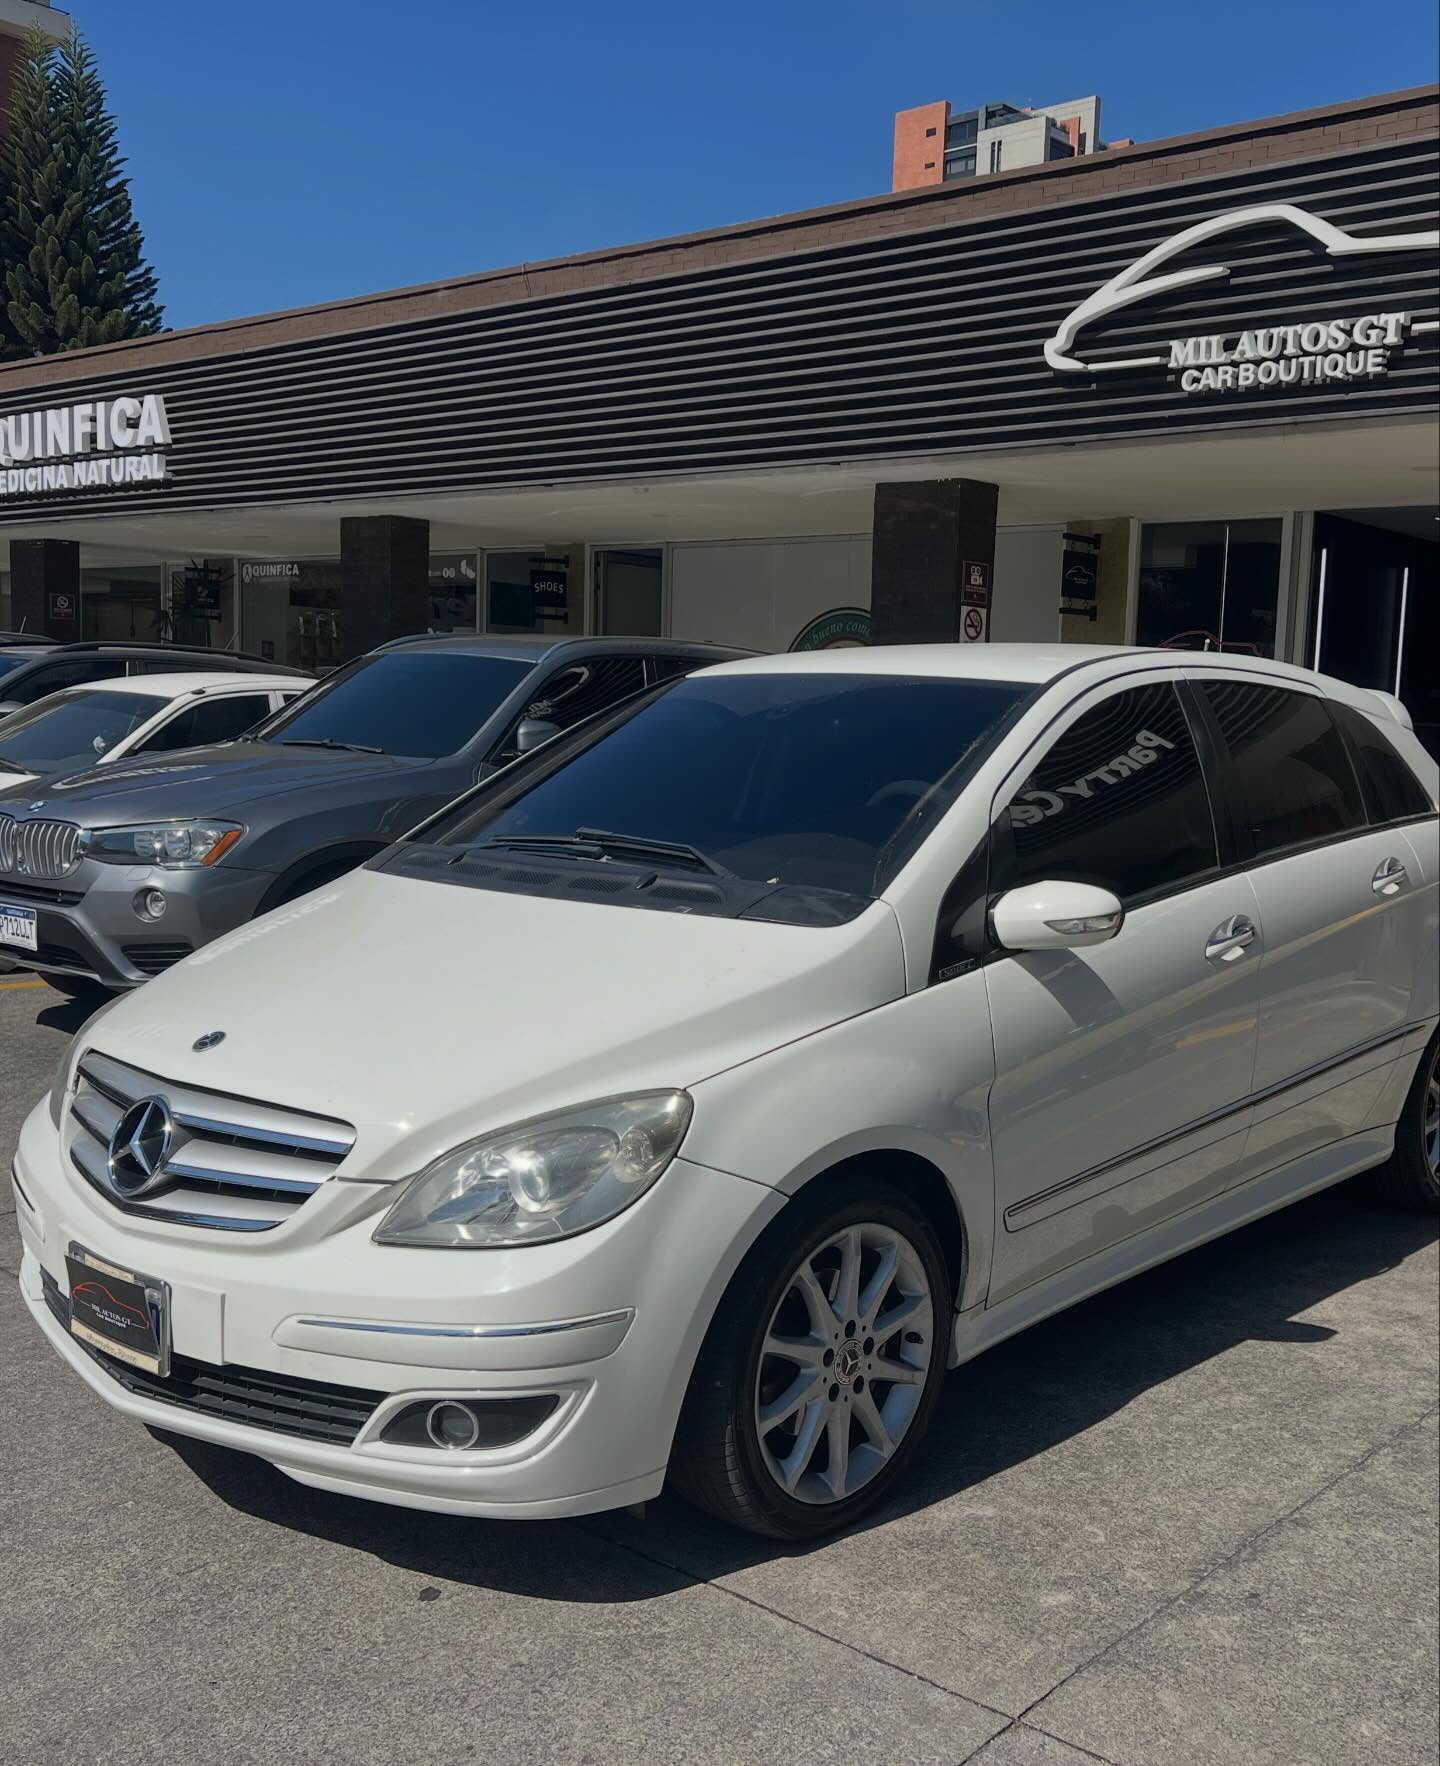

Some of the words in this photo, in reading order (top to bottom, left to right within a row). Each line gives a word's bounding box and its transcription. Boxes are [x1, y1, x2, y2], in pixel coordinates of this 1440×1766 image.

[1168, 336, 1227, 368] MIL
[1231, 320, 1349, 361] AUTOS
[1353, 312, 1406, 346] GT
[1181, 366, 1234, 391] CAR
[1238, 349, 1386, 386] BOUTIQUE
[0, 394, 172, 466] UINFICA
[73, 454, 165, 485] NATURAL
[252, 564, 300, 578] QUINFICA
[534, 581, 564, 594] SHOES
